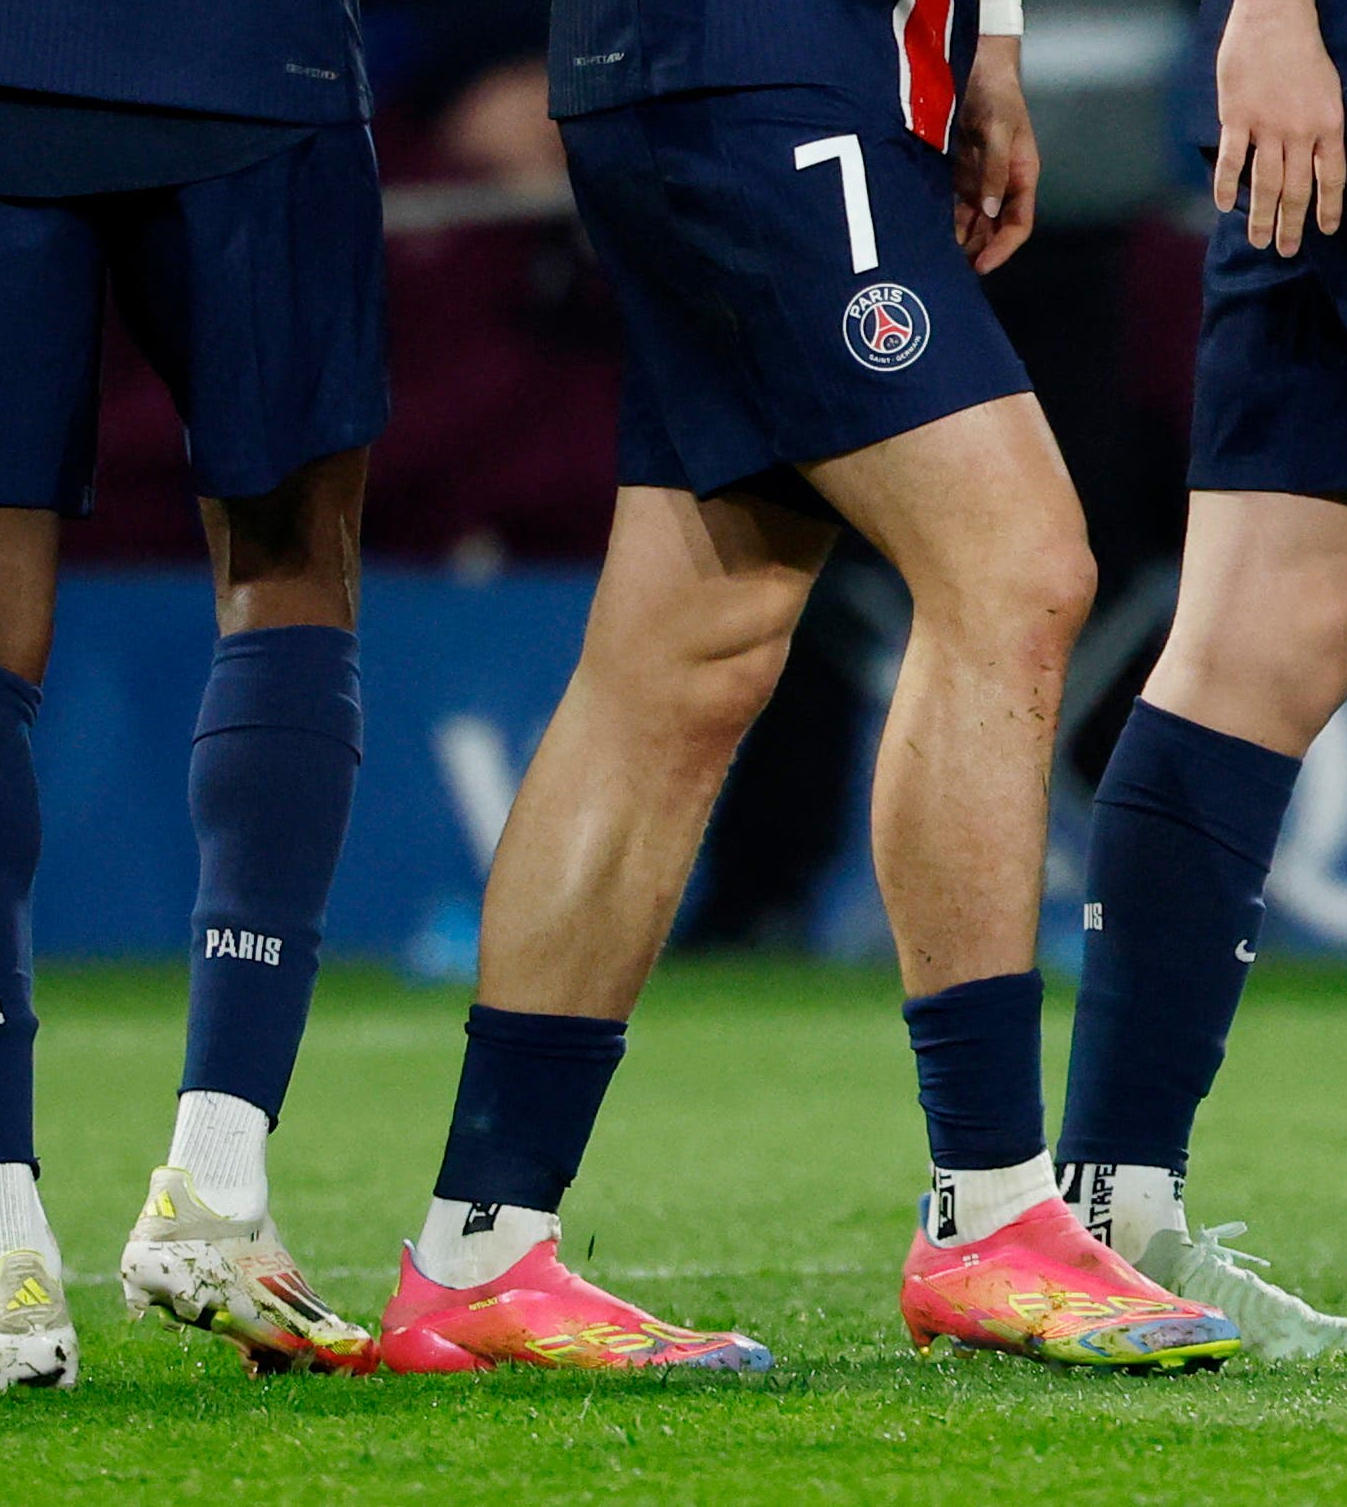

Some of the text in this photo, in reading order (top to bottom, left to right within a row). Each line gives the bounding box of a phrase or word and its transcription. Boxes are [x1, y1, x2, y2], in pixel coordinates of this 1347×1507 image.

[794, 134, 879, 274] 7
[849, 288, 903, 319] PARIS
[206, 928, 283, 967] PARIS
